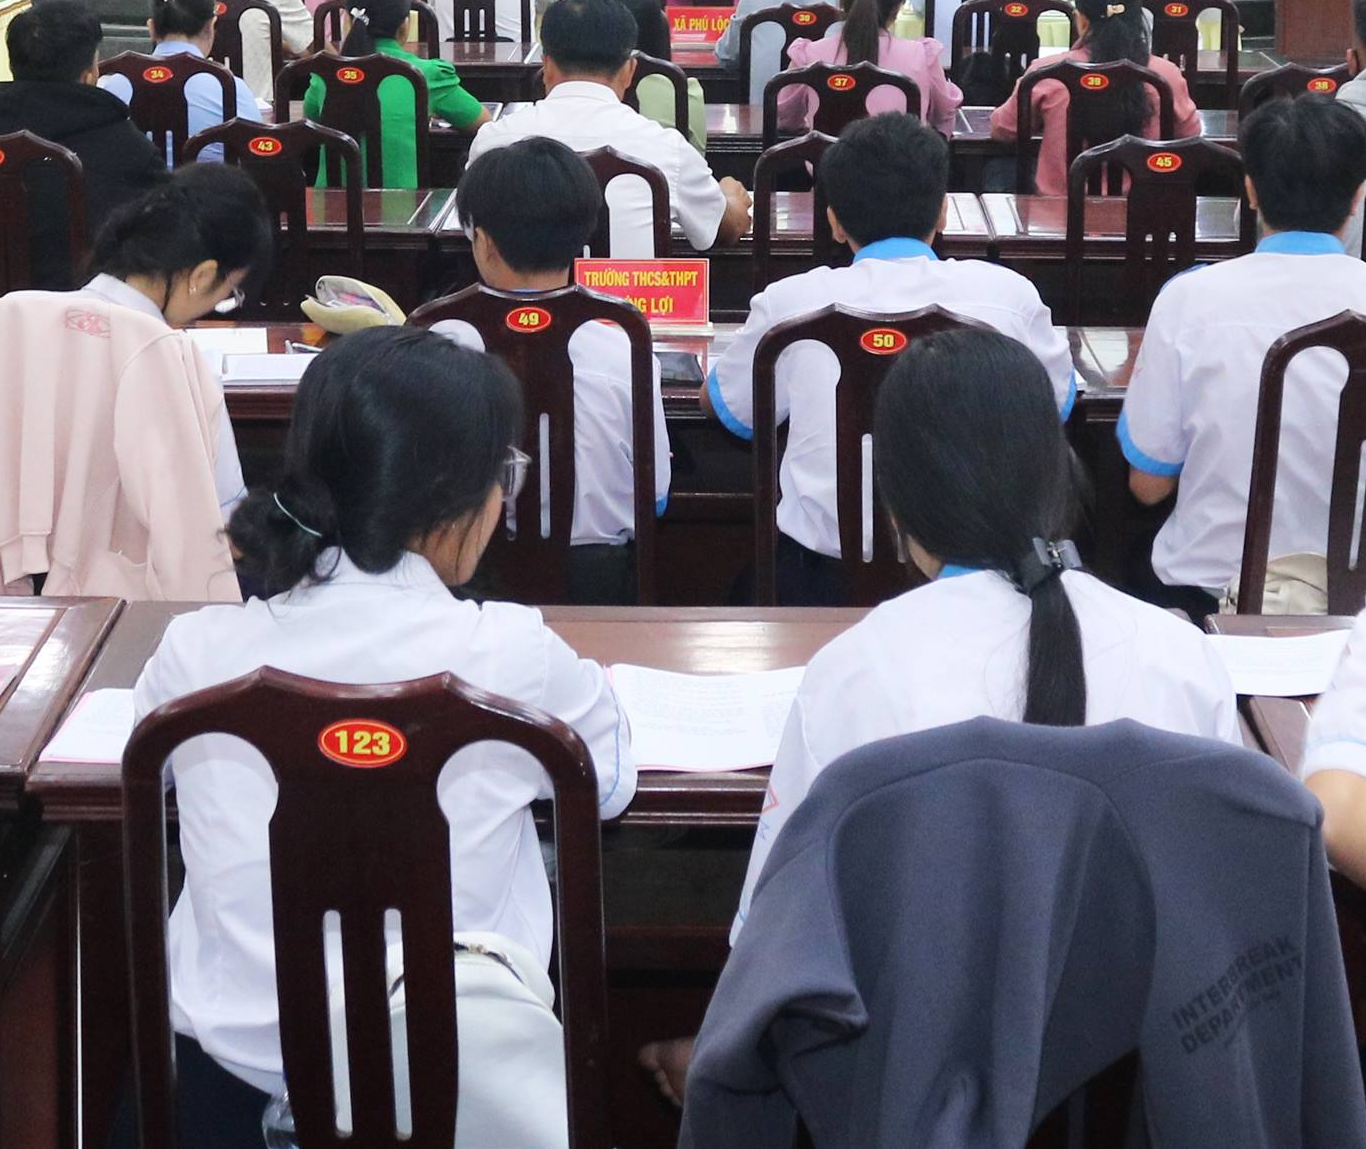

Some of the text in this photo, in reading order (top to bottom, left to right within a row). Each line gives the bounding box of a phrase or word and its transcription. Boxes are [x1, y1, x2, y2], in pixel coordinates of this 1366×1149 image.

[673, 15, 686, 31] XÃ
[689, 15, 708, 31] PHÚ
[151, 70, 164, 79] 34
[344, 70, 357, 80] 35
[835, 77, 848, 86] 37
[257, 141, 273, 151] 43
[1156, 156, 1172, 167] 45
[584, 268, 698, 287] TRƯỜNG THCS&THPT
[651, 295, 673, 315] LỢI
[518, 312, 539, 326] 49
[873, 334, 894, 348] 50
[334, 730, 390, 756] 123
